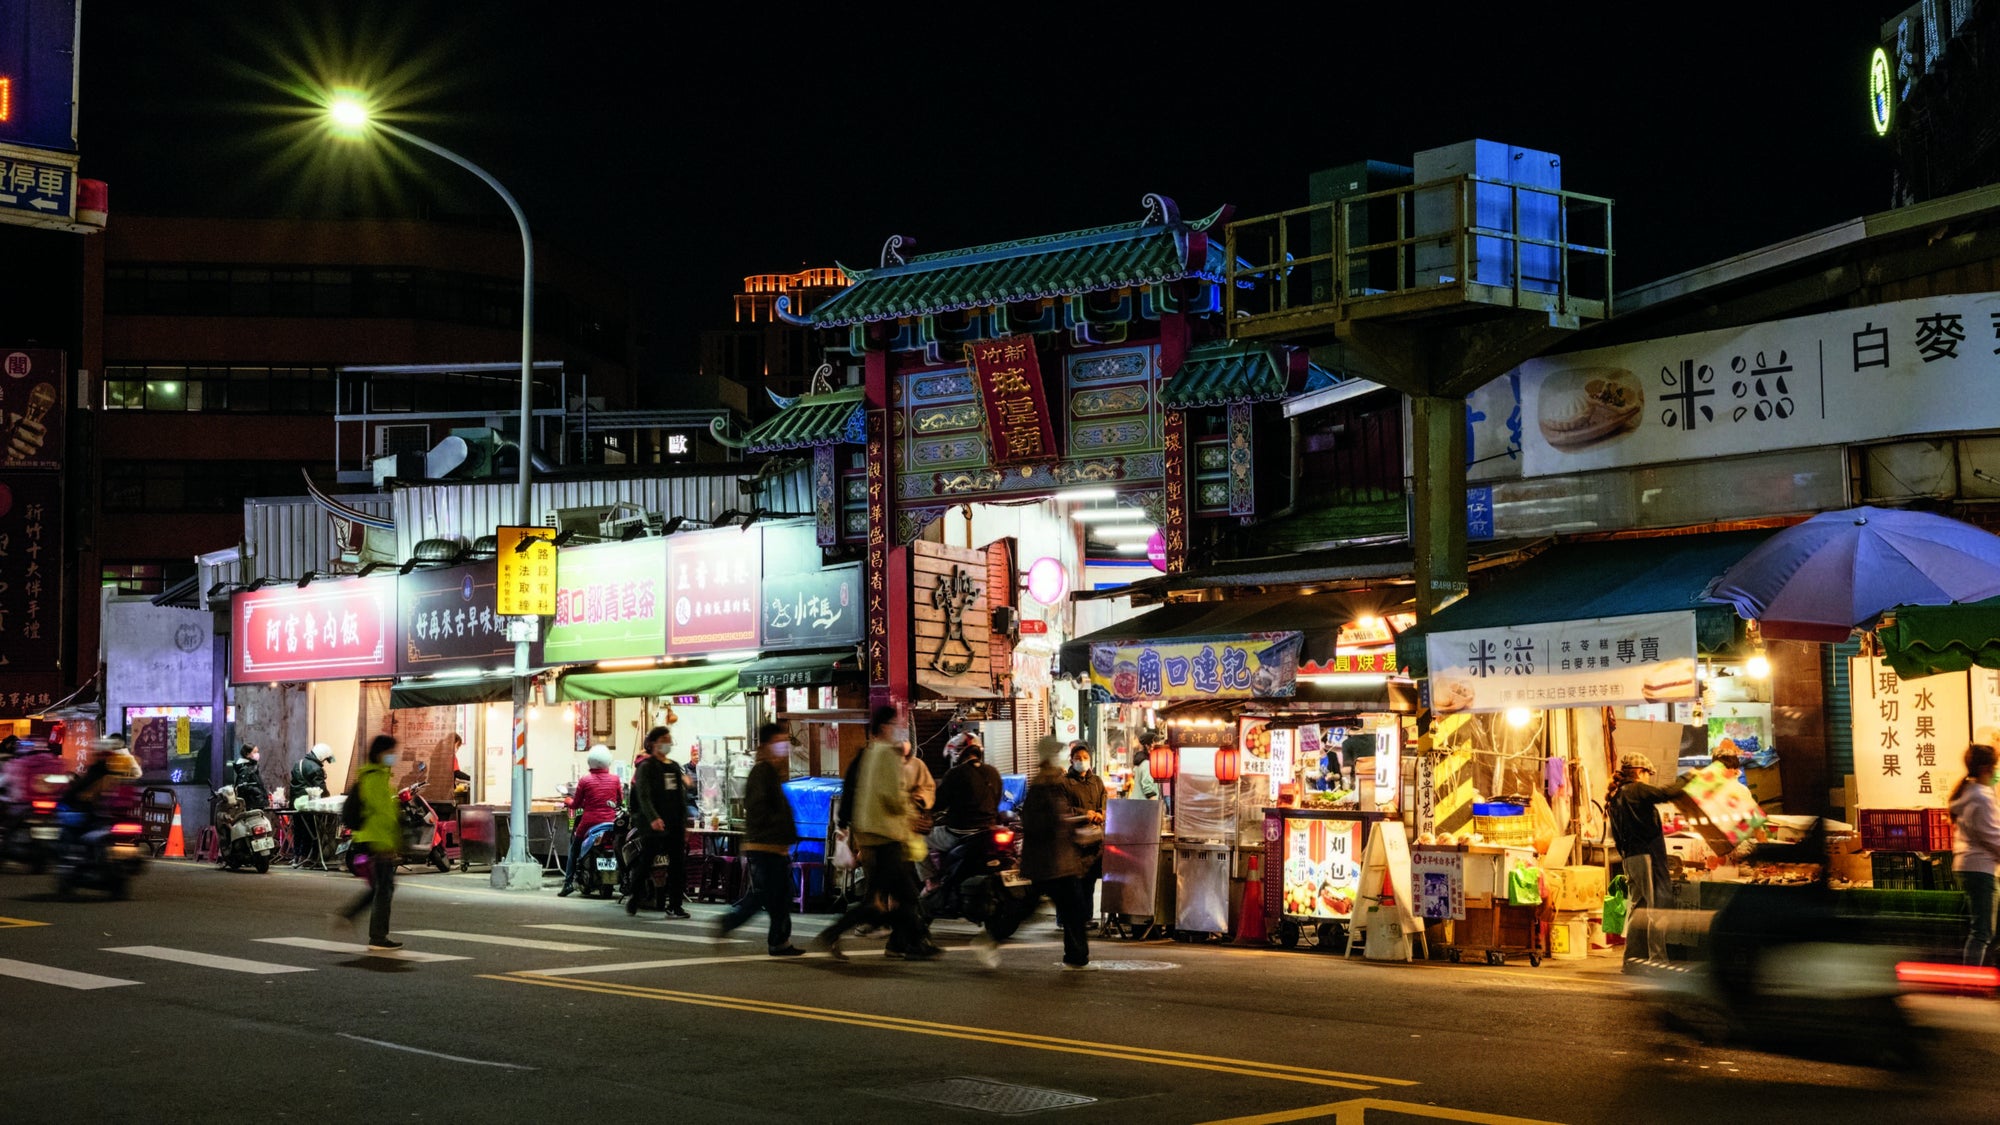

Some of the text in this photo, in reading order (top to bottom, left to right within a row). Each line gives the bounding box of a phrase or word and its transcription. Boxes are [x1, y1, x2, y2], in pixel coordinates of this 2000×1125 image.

[1851, 312, 2000, 373] 白麥
[990, 367, 1041, 456] 城隍廟
[23, 503, 44, 639] 新竹十大伴手禮
[266, 610, 360, 653] 阿富魯肉飯
[1616, 637, 1660, 664] 專賣
[1137, 644, 1252, 695] 廟口連記
[1561, 655, 1610, 670] 白麥芽糖
[1879, 672, 1901, 777] 現切水果
[1914, 687, 1937, 794] 水果禮盒
[1330, 836, 1346, 881] 刈包
